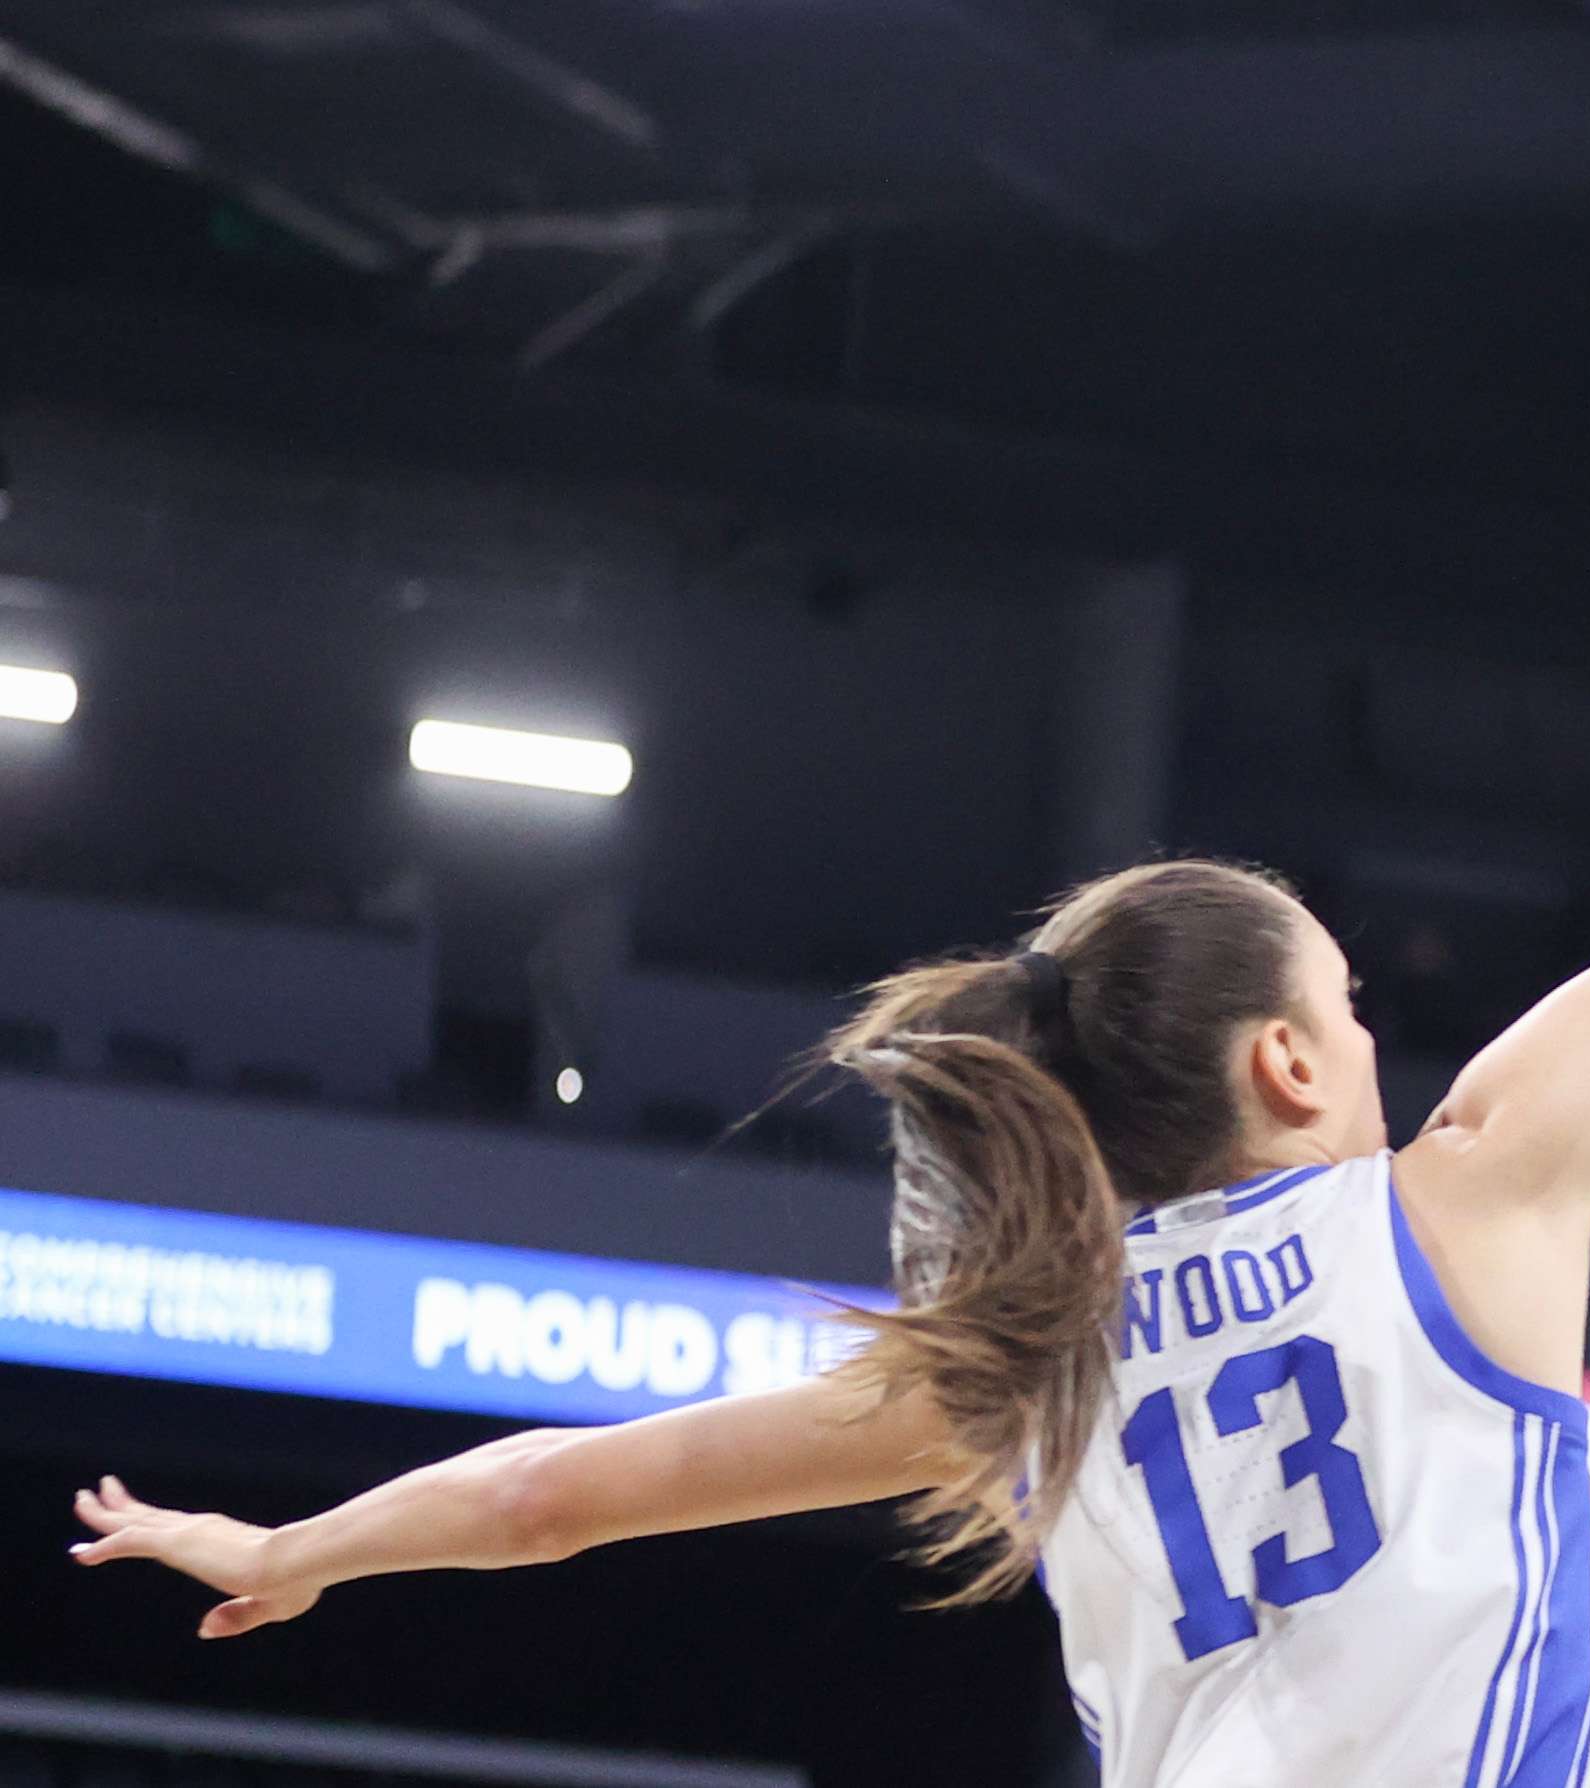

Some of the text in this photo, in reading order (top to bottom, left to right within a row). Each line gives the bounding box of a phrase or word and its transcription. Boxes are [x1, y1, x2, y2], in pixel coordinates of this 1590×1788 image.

[412, 1277, 719, 1398] PROUD
[1117, 1233, 1314, 1360] WOOD
[1120, 1334, 1383, 1663] 13
